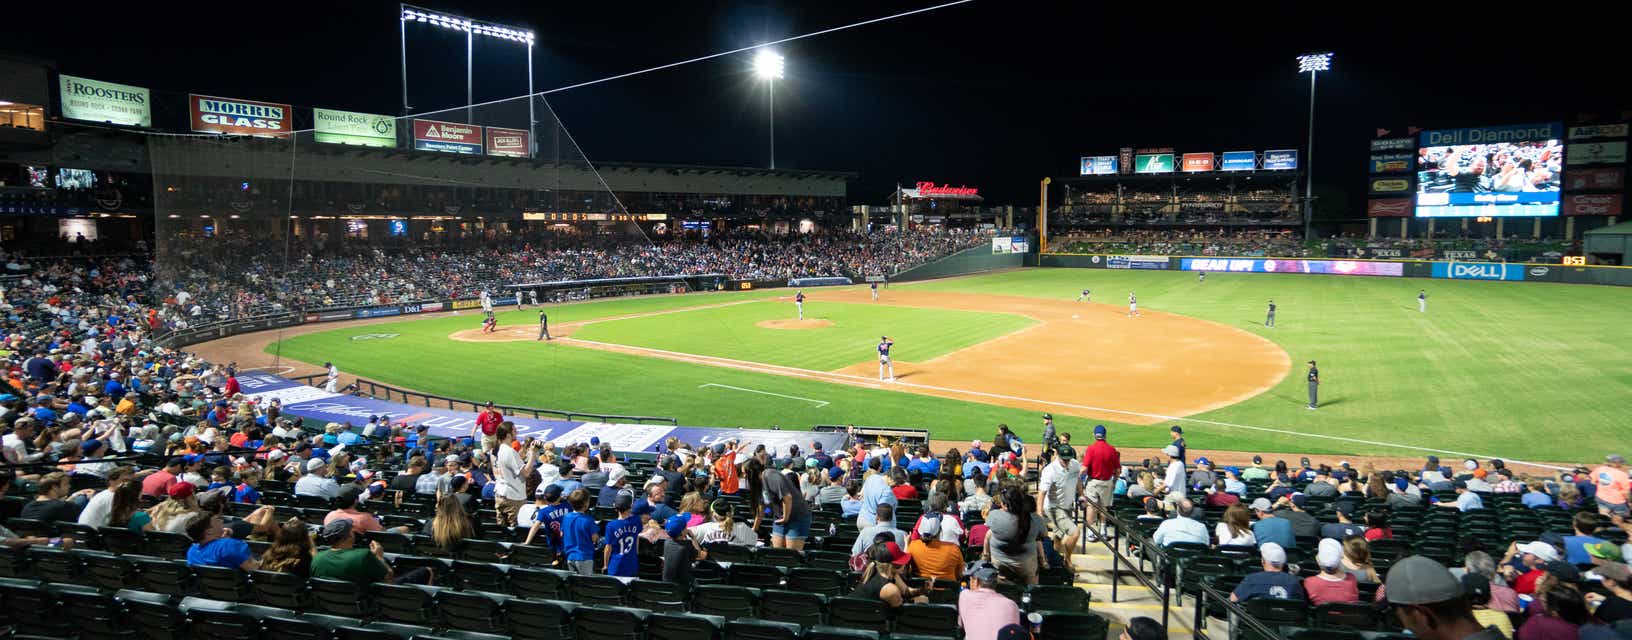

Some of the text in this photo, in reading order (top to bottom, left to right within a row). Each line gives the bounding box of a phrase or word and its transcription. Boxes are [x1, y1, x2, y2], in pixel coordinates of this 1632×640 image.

[73, 83, 145, 104] ROOSTERS
[203, 101, 282, 118] MORRIS
[201, 114, 281, 130] GLASS
[318, 112, 369, 124] Round Rock
[441, 125, 473, 136] Benjamin
[441, 132, 465, 140] Moore
[1430, 124, 1552, 144] Dell Diamond
[916, 181, 979, 196] Budweiser
[1445, 251, 1476, 259] TEXAS
[1455, 265, 1500, 277] DELL
[614, 526, 637, 539] GALLO
[618, 536, 635, 555] 13
